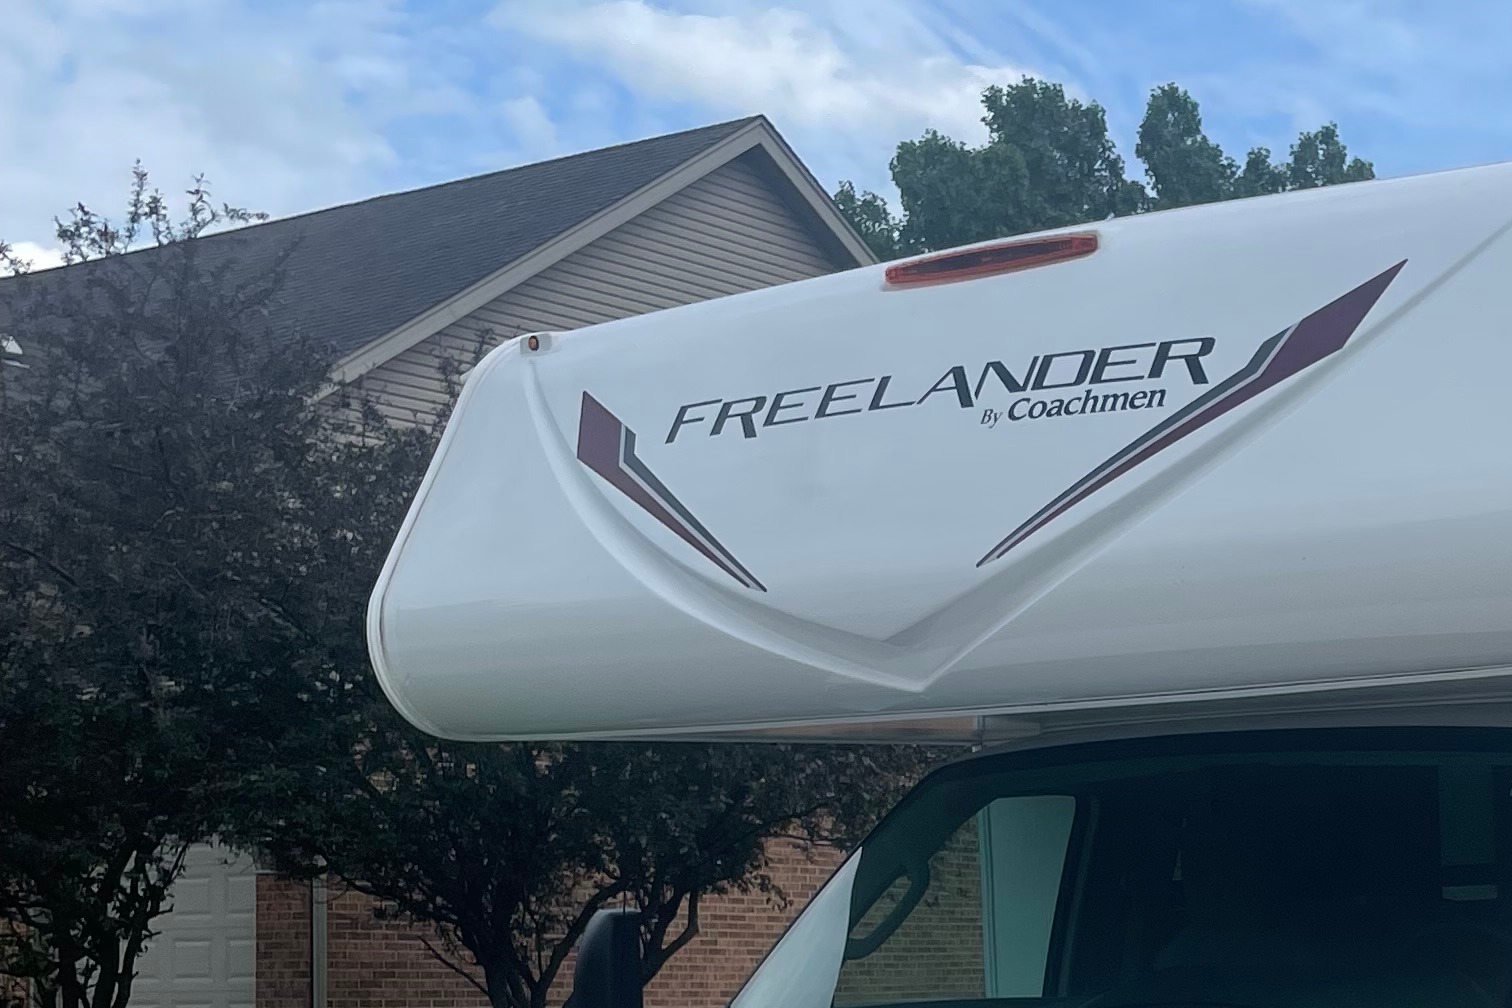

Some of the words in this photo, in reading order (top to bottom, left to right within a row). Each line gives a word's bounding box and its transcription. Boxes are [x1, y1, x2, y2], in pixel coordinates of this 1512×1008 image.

[665, 336, 1216, 445] FREELANDER
[980, 408, 1004, 429] By
[1007, 389, 1167, 422] Coachmen
